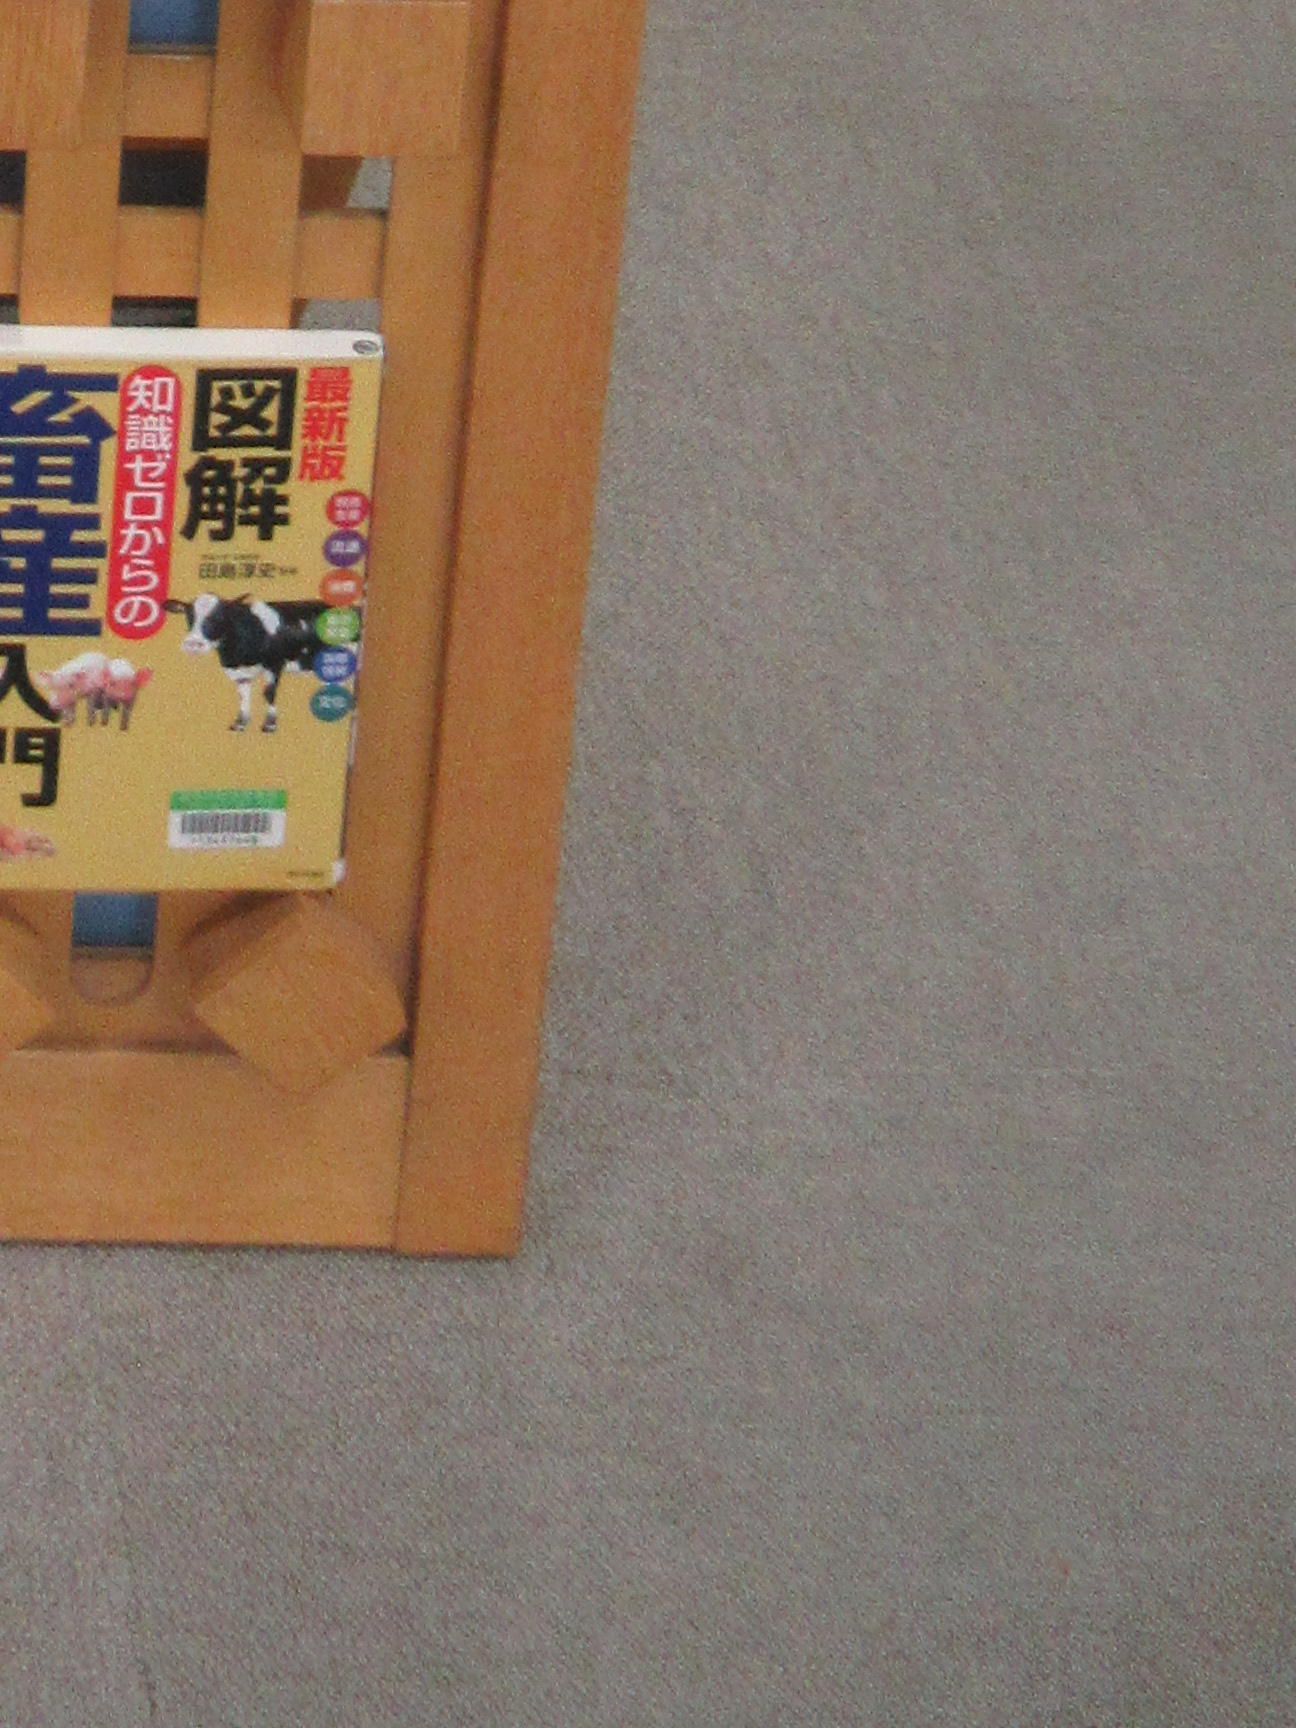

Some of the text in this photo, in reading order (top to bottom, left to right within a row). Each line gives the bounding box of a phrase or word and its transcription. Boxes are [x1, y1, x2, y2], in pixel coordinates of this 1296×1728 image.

[113, 375, 176, 629] 知識ゼロからの
[180, 367, 297, 542] 図解
[298, 366, 353, 481] 最新版
